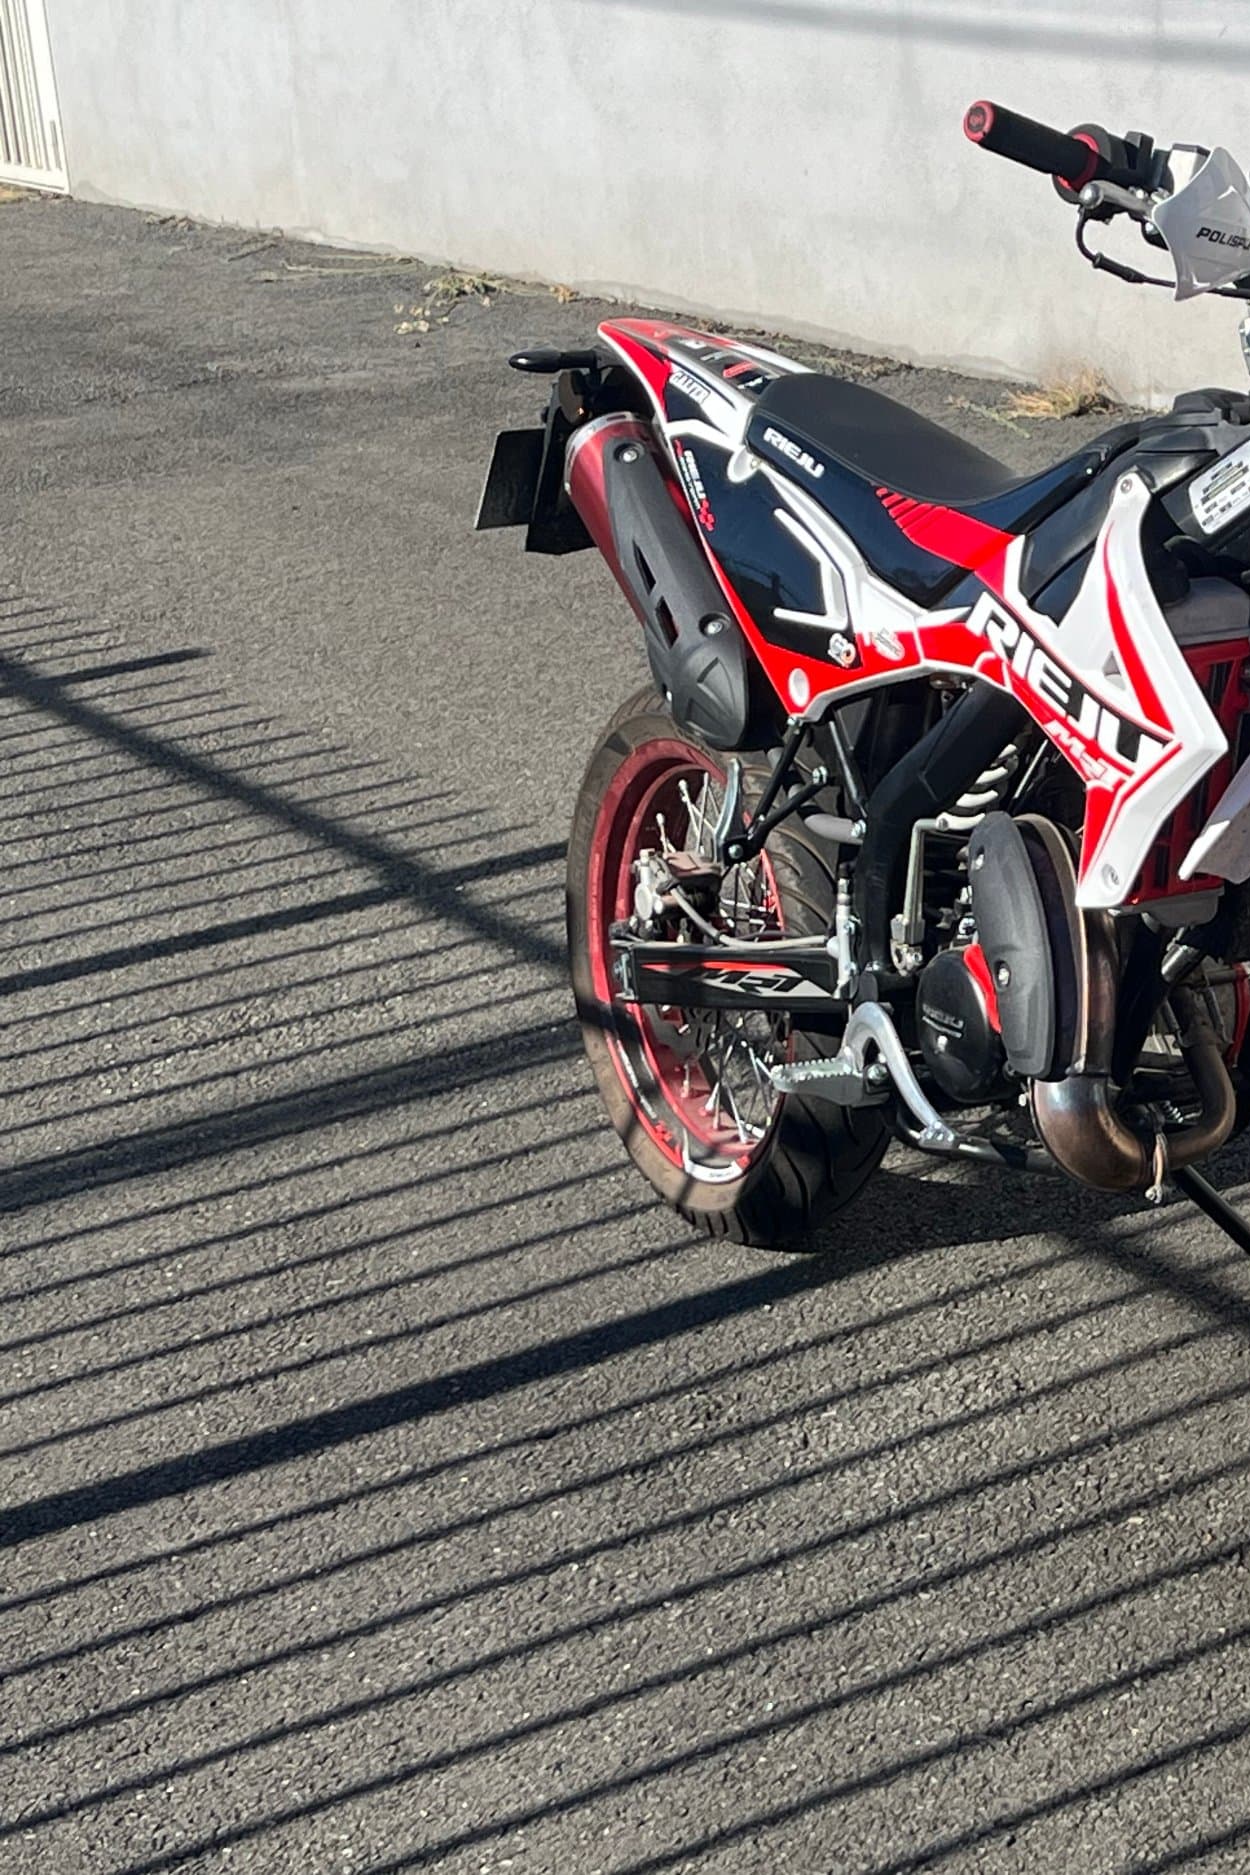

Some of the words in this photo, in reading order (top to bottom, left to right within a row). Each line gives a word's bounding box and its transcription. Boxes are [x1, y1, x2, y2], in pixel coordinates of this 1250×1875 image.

[763, 427, 825, 478] RIEJU
[965, 591, 1165, 775] RIEJU
[702, 969, 804, 995] MRT
